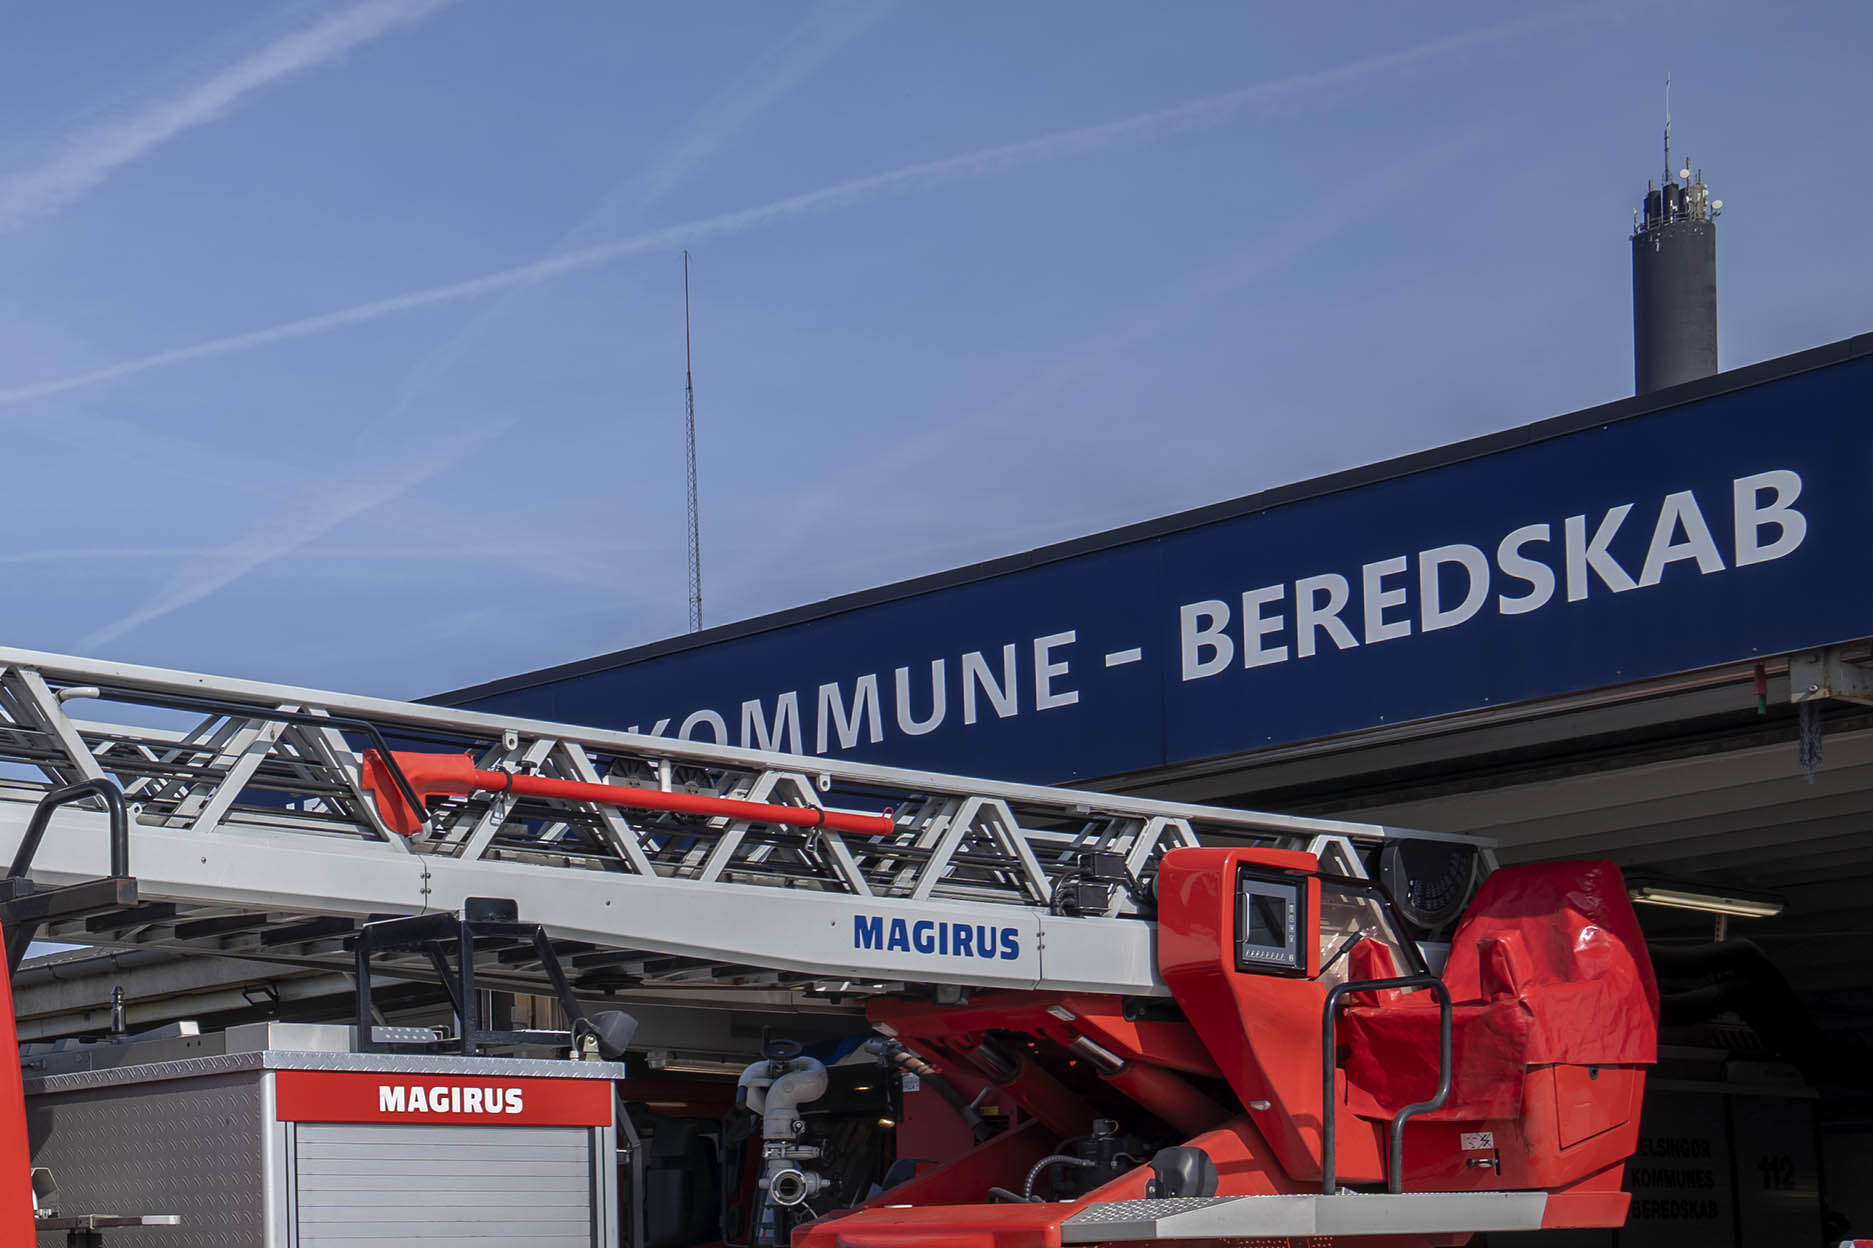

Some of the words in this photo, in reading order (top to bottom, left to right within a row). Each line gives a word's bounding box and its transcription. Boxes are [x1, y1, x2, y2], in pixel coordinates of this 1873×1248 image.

[1104, 646, 1143, 668] -
[1180, 469, 1808, 682] BEREDSKAB
[853, 914, 1020, 961] MAGIRUS
[378, 1085, 524, 1114] MAGIRUS
